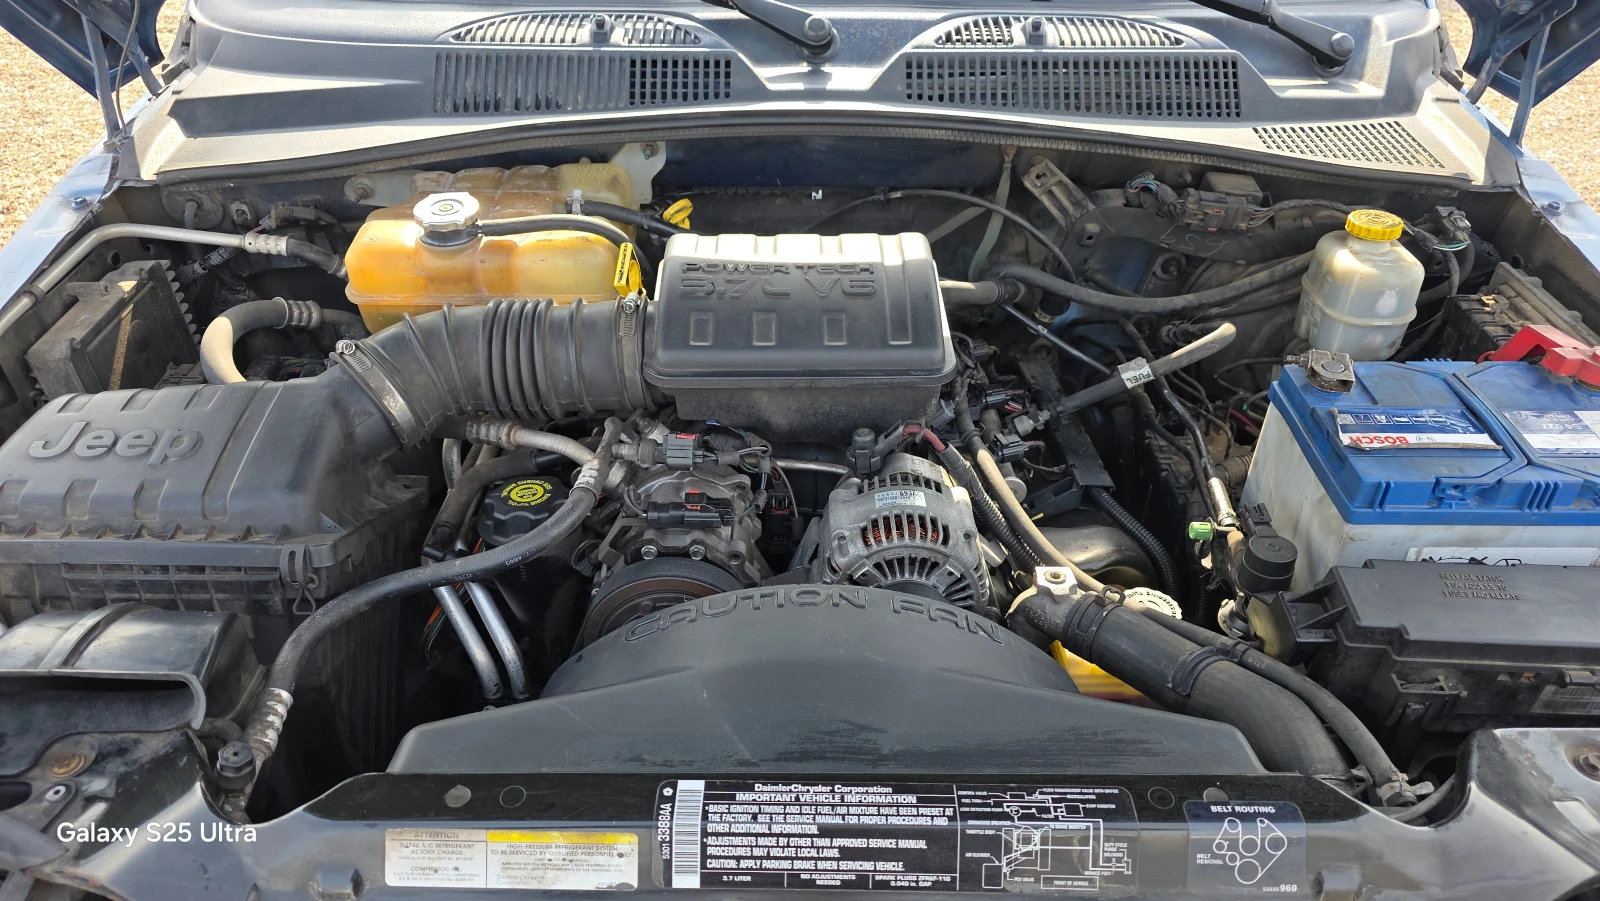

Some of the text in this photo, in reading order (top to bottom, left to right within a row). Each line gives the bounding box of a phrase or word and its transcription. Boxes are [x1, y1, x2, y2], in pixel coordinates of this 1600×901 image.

[680, 275, 877, 298] 3.7L V6
[1126, 371, 1151, 384] FUEL
[28, 421, 204, 467] Jeep
[1349, 436, 1409, 444] BOSCH
[624, 588, 868, 642] CAUTION
[890, 597, 1002, 645] FAN
[755, 784, 892, 794] DaimlerChrysler Corporation
[736, 793, 916, 804] IMPORTANT VEHICLE INFORMATION
[730, 805, 759, 813] IGNITION
[817, 806, 847, 815] FUEL/AIR
[815, 815, 844, 823] MANUAL
[860, 816, 886, 824] PROPER
[888, 816, 932, 824] PROCEDURES
[933, 817, 948, 825] AND
[707, 824, 819, 834] OTHER ADDITIONAL INFORMATION.
[707, 836, 927, 848] ADJUSTMENTS MADE BY OTHER THAN APPROVED SERVICE MANUAL
[707, 847, 840, 857] PROCEDURES MAY VIOLATE LOCAL LAWS.
[707, 859, 905, 871] CAUTION: APPLY PARKING BRAKE WHEN SERVICING VEHICLE.
